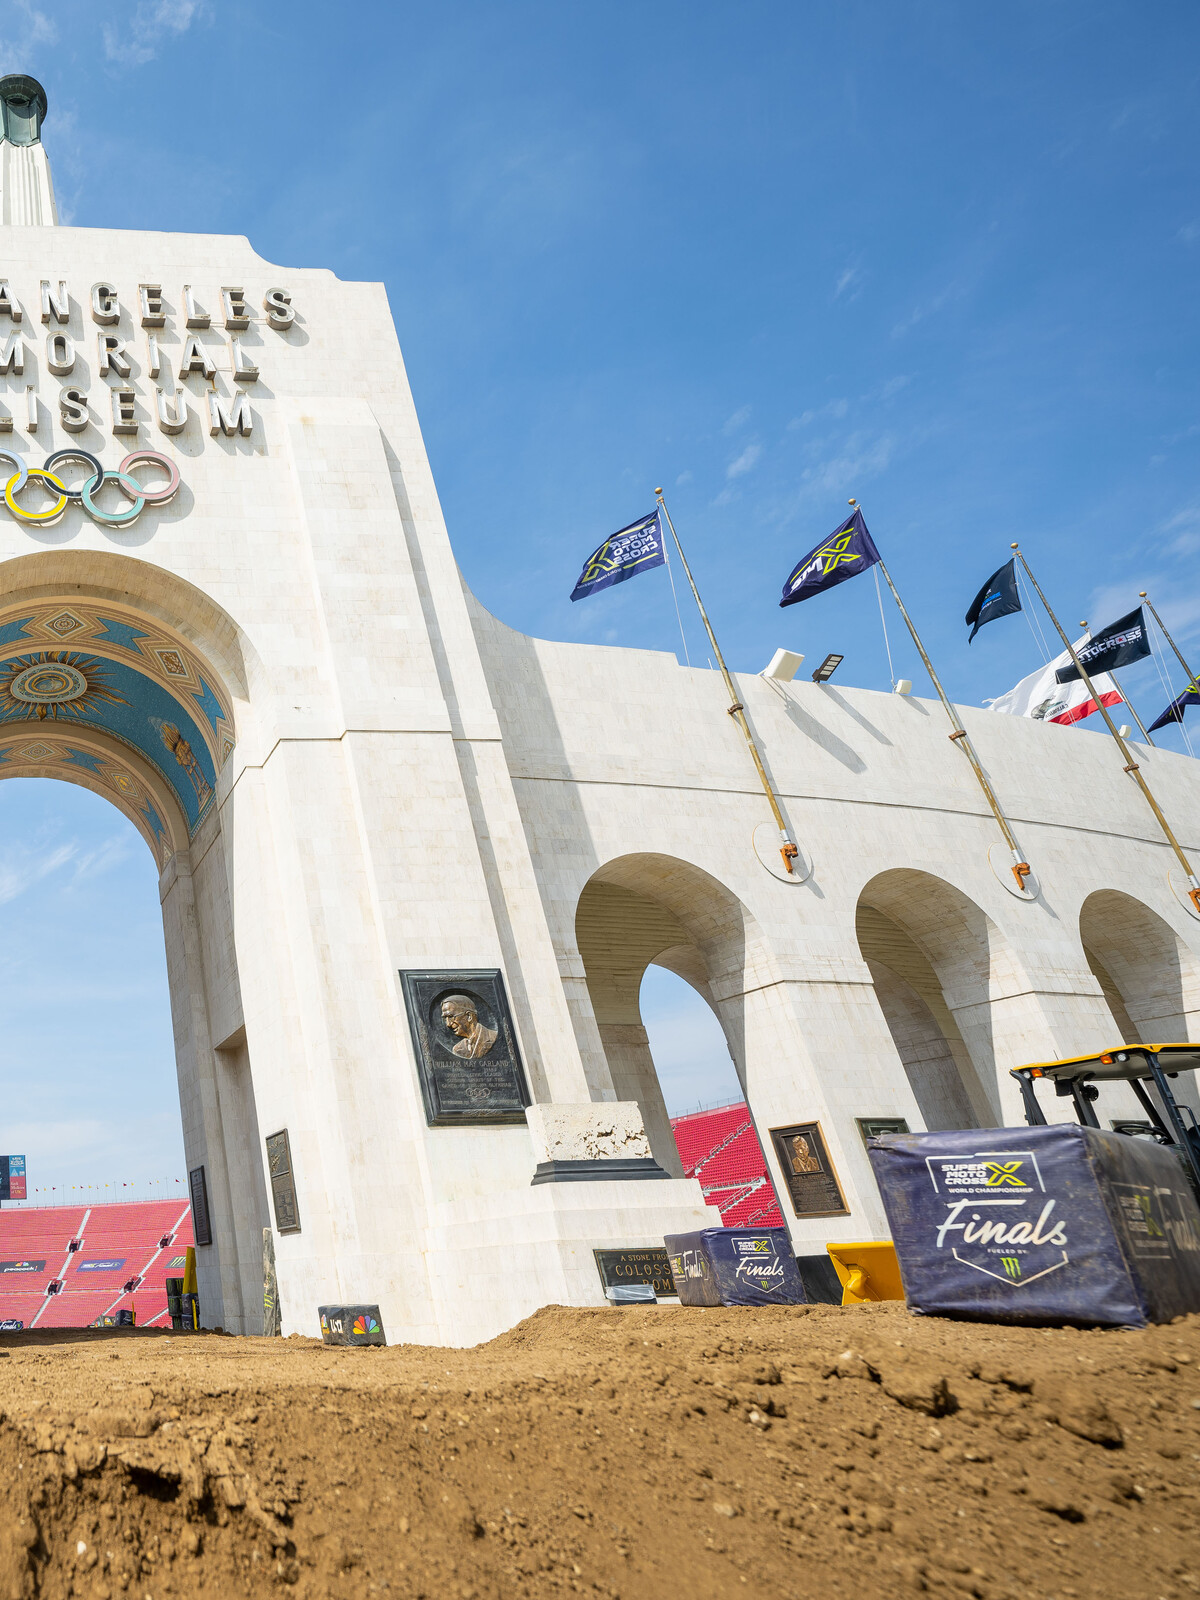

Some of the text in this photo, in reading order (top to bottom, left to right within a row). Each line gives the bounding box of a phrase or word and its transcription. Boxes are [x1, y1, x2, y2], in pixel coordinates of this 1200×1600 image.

[941, 1164, 987, 1172] SUPER
[936, 1198, 1068, 1248] Finals
[652, 1253, 669, 1261] FRO
[615, 1264, 671, 1277] COLOSS
[736, 1256, 784, 1278] Finals
